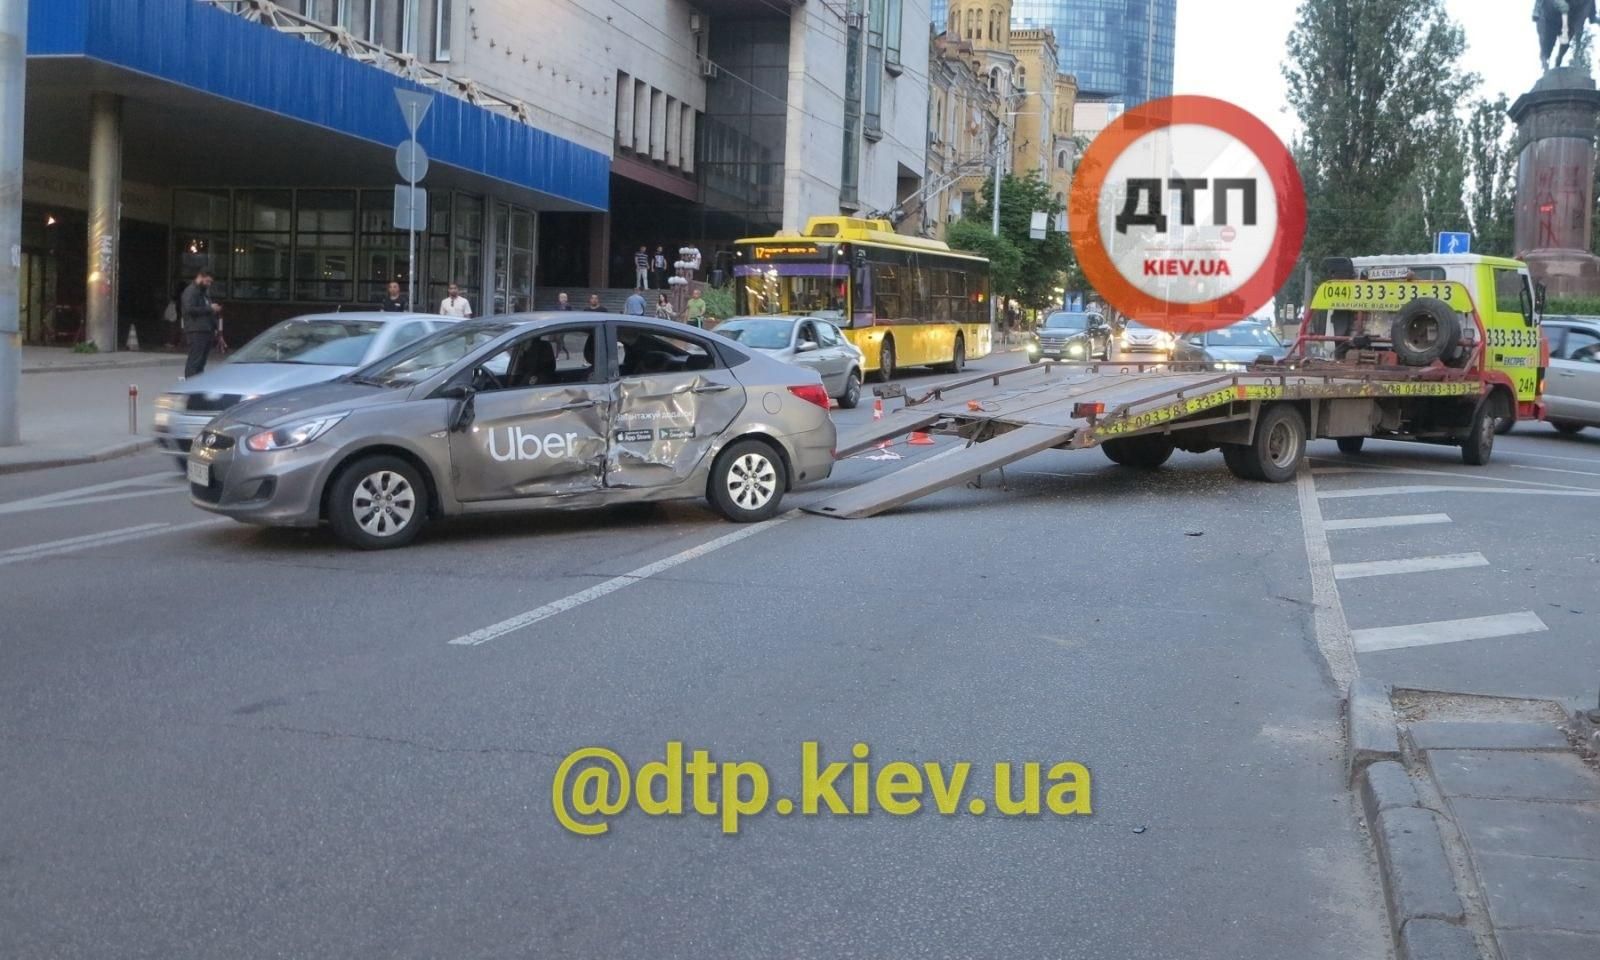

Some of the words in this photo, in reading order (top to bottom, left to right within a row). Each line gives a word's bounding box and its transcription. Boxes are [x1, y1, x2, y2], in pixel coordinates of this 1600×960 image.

[1323, 285, 1351, 300] (044)
[1486, 328, 1537, 348] 333-33-33
[1518, 377, 1534, 393] 24h
[1135, 411, 1160, 427] 093
[488, 426, 578, 462] Uber
